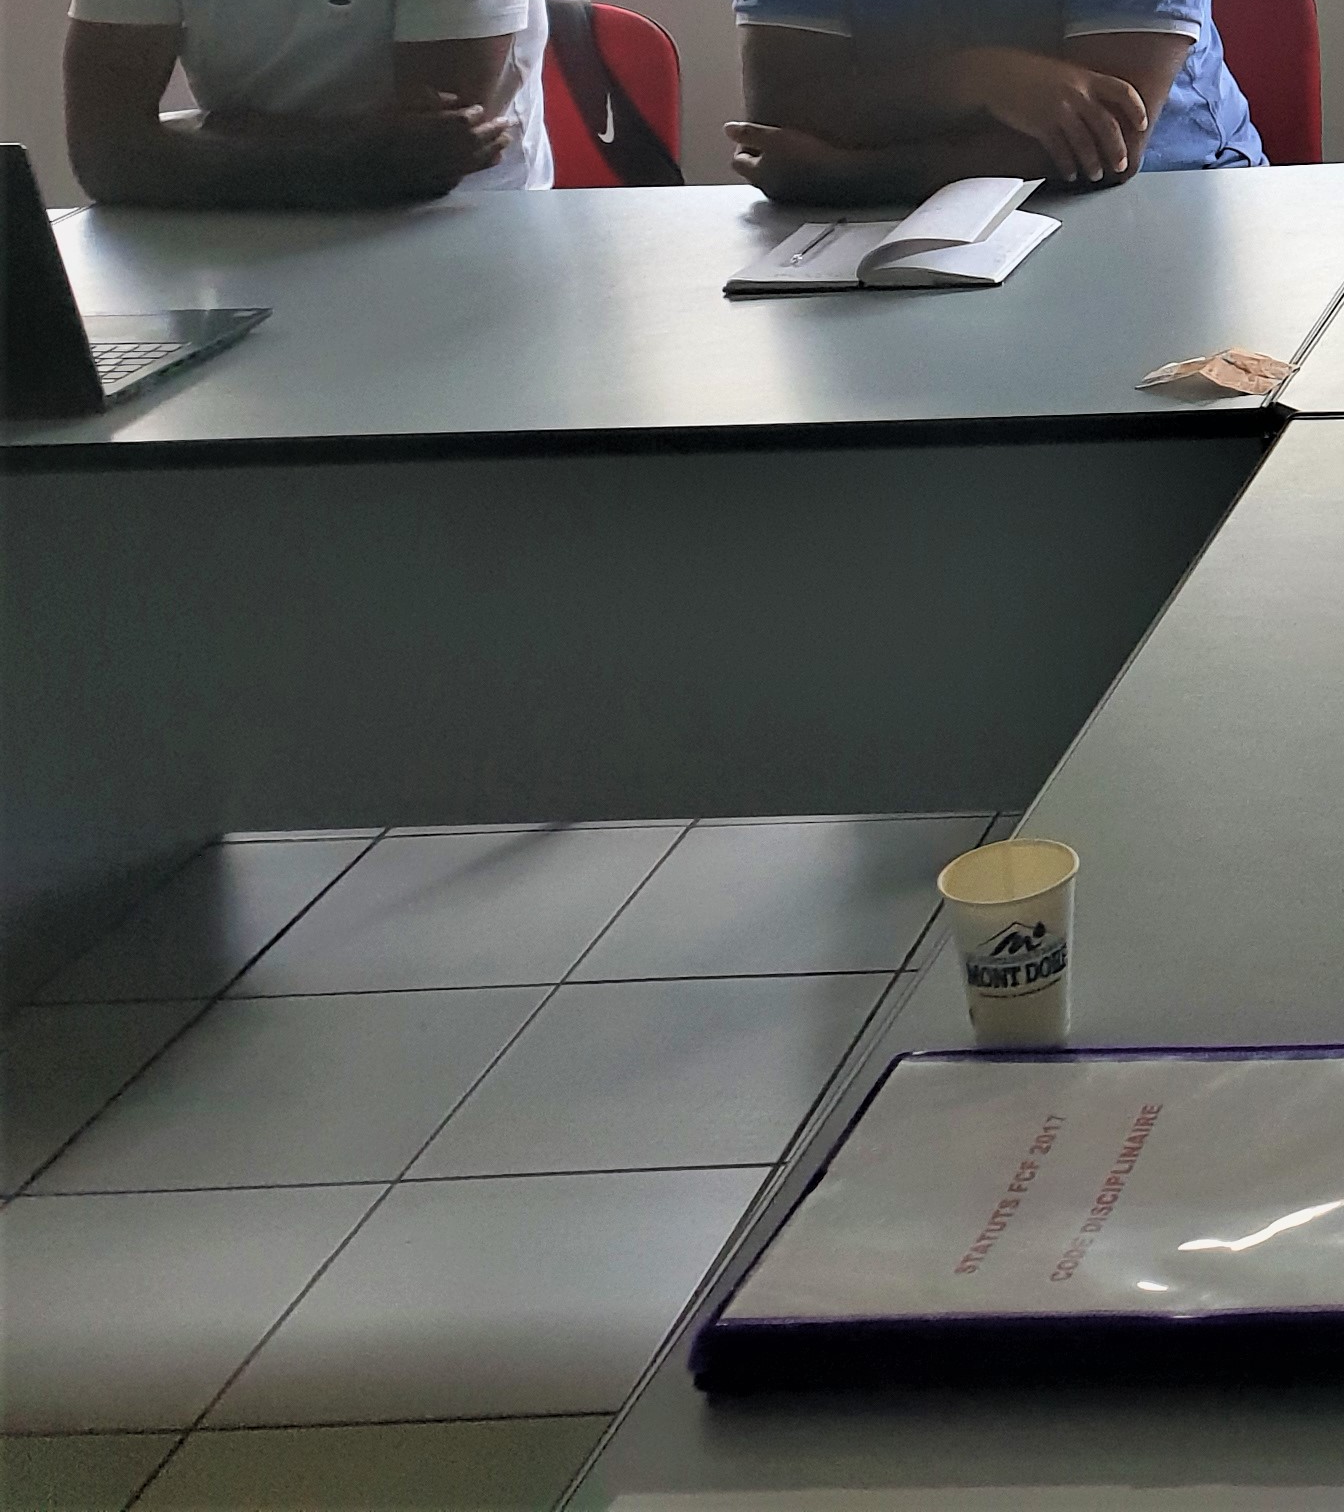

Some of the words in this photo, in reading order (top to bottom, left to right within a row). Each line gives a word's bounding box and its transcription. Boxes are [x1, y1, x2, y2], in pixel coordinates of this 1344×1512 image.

[954, 1198, 1021, 1275] STATUTS
[1007, 1160, 1039, 1193] FCF
[1029, 1114, 1067, 1155] 2017
[1050, 1237, 1095, 1282] CODE
[1081, 1103, 1163, 1234] DISCIPLINAIRE
